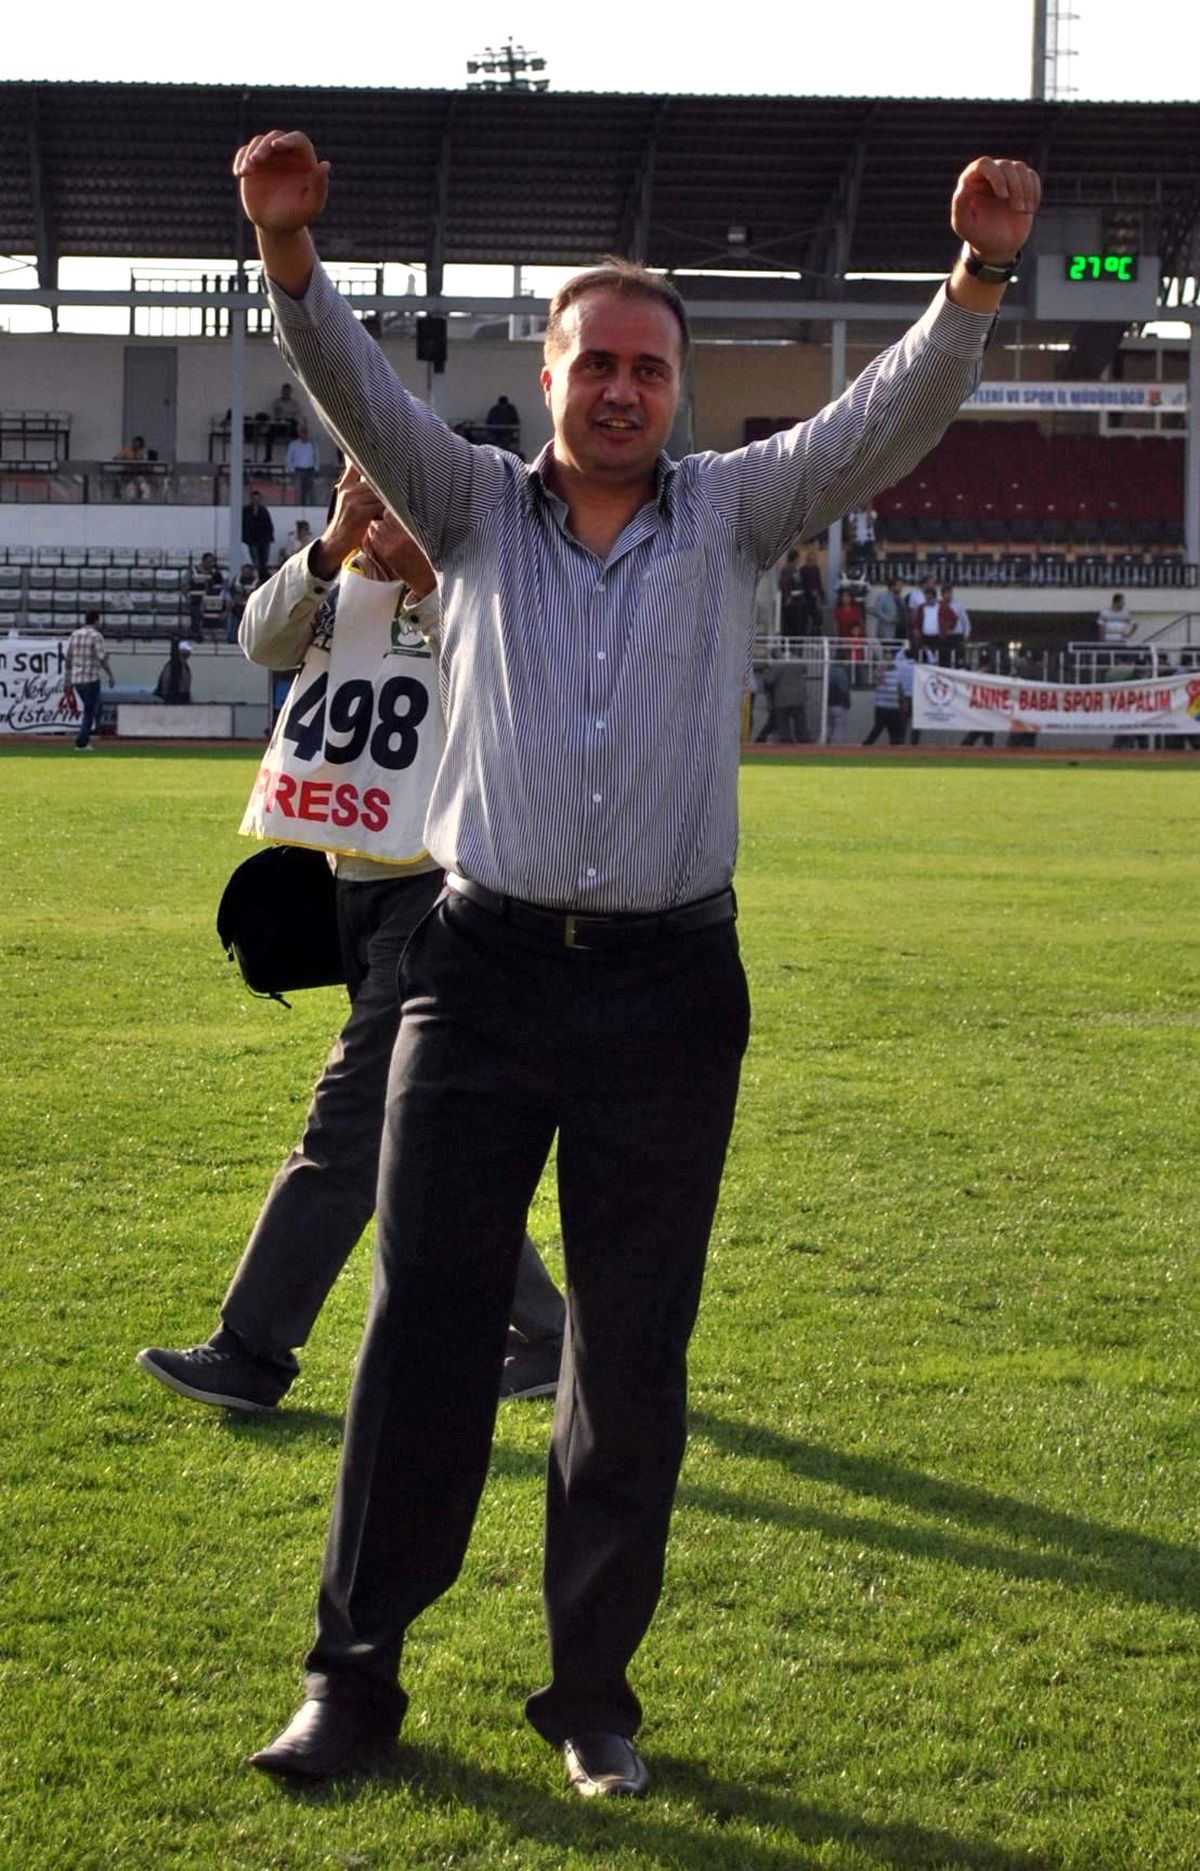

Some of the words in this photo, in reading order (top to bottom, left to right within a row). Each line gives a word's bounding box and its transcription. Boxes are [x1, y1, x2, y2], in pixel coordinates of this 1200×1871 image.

[1023, 389, 1055, 404] SPOR
[1018, 689, 1058, 711] BABA
[1063, 690, 1103, 712] SPOR
[1108, 688, 1171, 711] YAPALIM
[284, 671, 430, 770] 498
